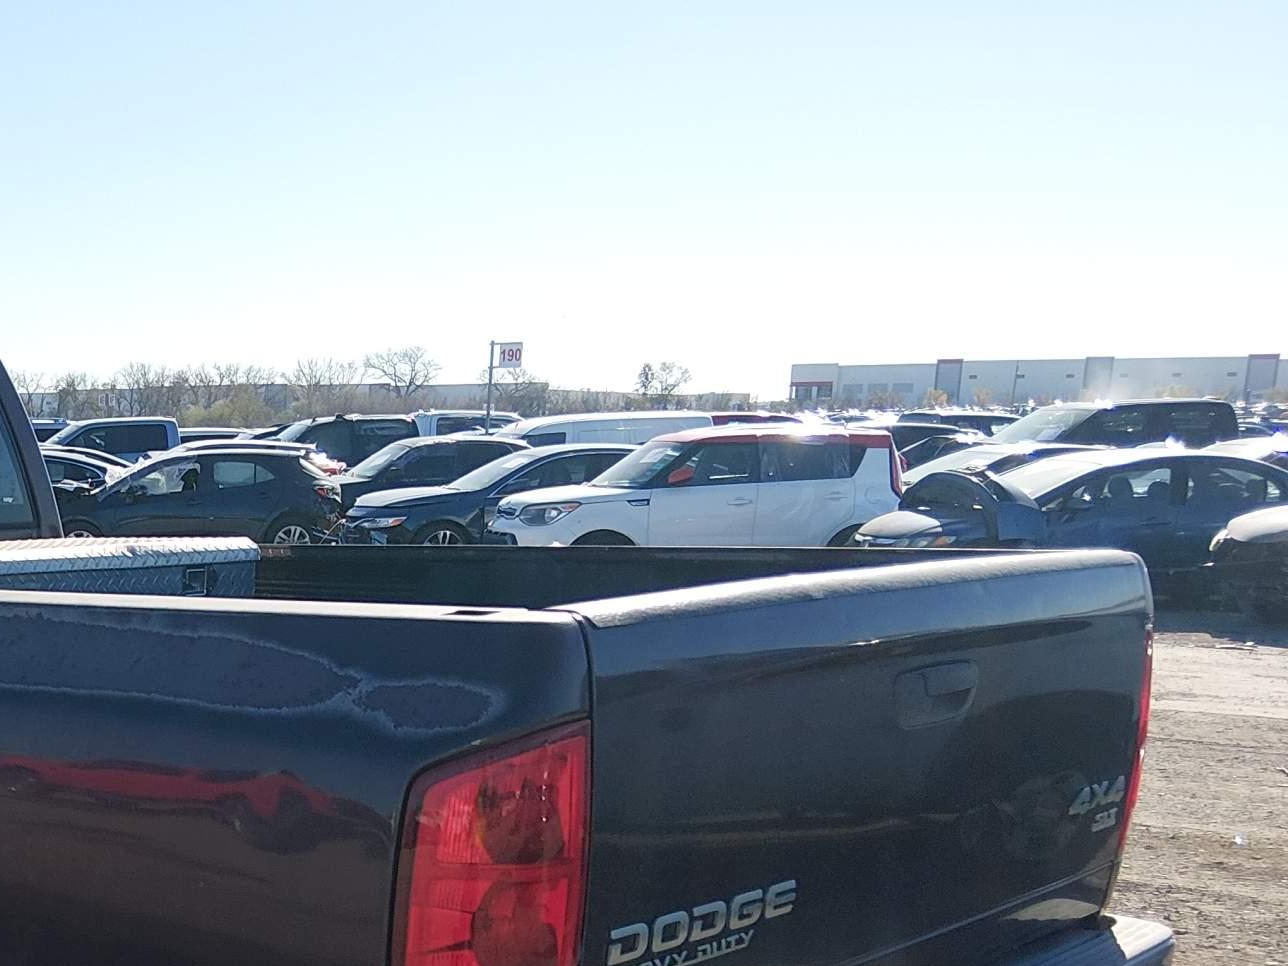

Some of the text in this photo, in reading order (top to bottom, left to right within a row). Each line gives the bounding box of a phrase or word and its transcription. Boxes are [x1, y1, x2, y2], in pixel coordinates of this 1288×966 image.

[501, 348, 522, 362] 190
[606, 879, 797, 966] DODGE
[696, 929, 755, 962] DUTY
